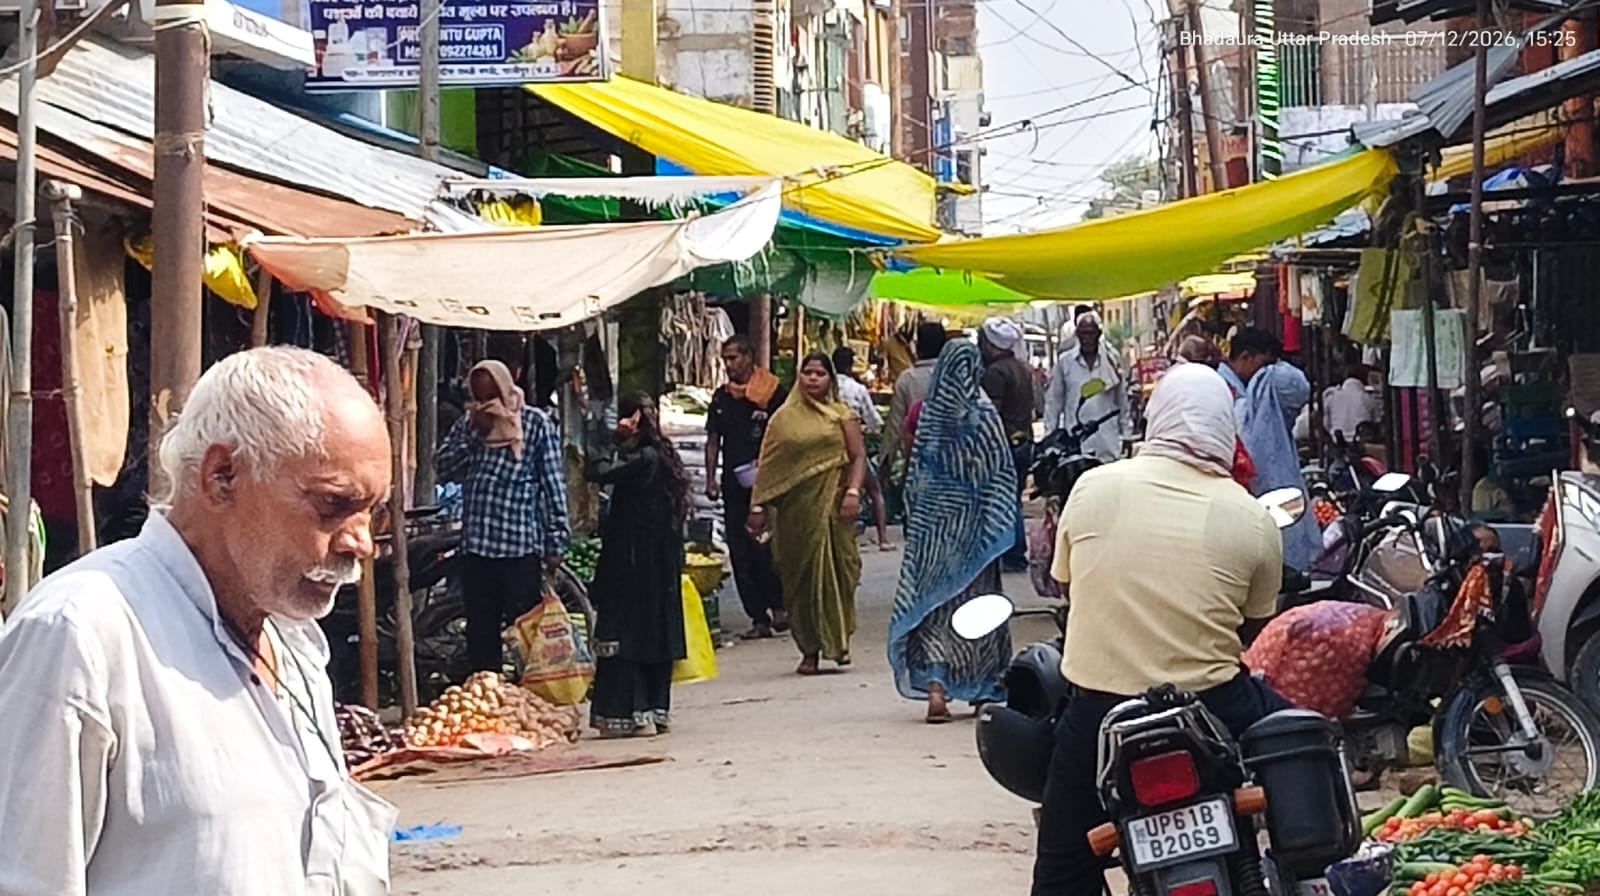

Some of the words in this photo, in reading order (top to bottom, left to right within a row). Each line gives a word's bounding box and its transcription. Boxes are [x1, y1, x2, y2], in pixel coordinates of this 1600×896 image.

[364, 4, 384, 19] की
[490, 5, 508, 17] पर
[464, 26, 501, 42] GUPTA
[1144, 805, 1214, 837] UP61B
[1150, 826, 1221, 858] B2069
